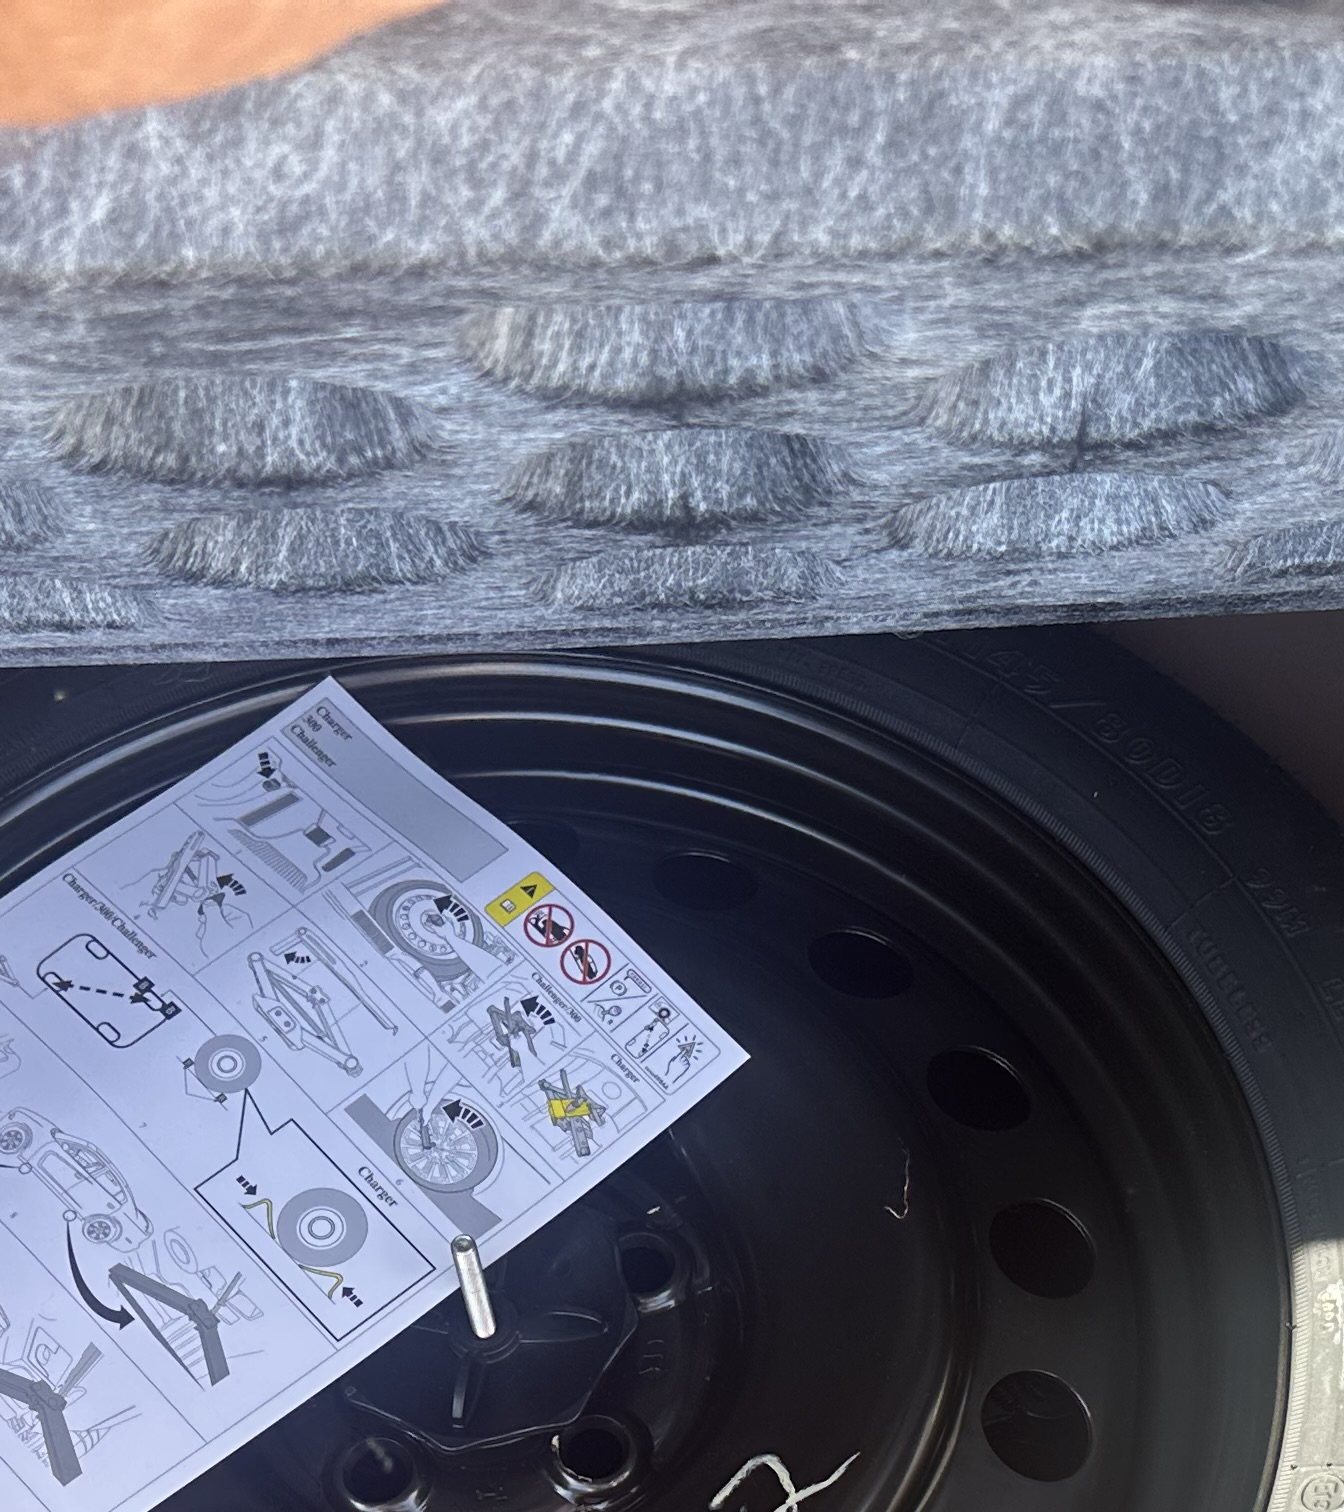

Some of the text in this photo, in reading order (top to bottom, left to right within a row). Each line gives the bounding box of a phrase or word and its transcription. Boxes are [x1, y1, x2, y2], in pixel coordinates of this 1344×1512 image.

[285, 723, 339, 769] Challenger
[300, 713, 324, 733] 300
[310, 704, 356, 743] Charger
[59, 870, 159, 964] Charger/300/Challenger
[526, 971, 585, 1023] Challenger/300
[607, 1052, 643, 1084] Charger
[352, 1164, 402, 1210] Charger
